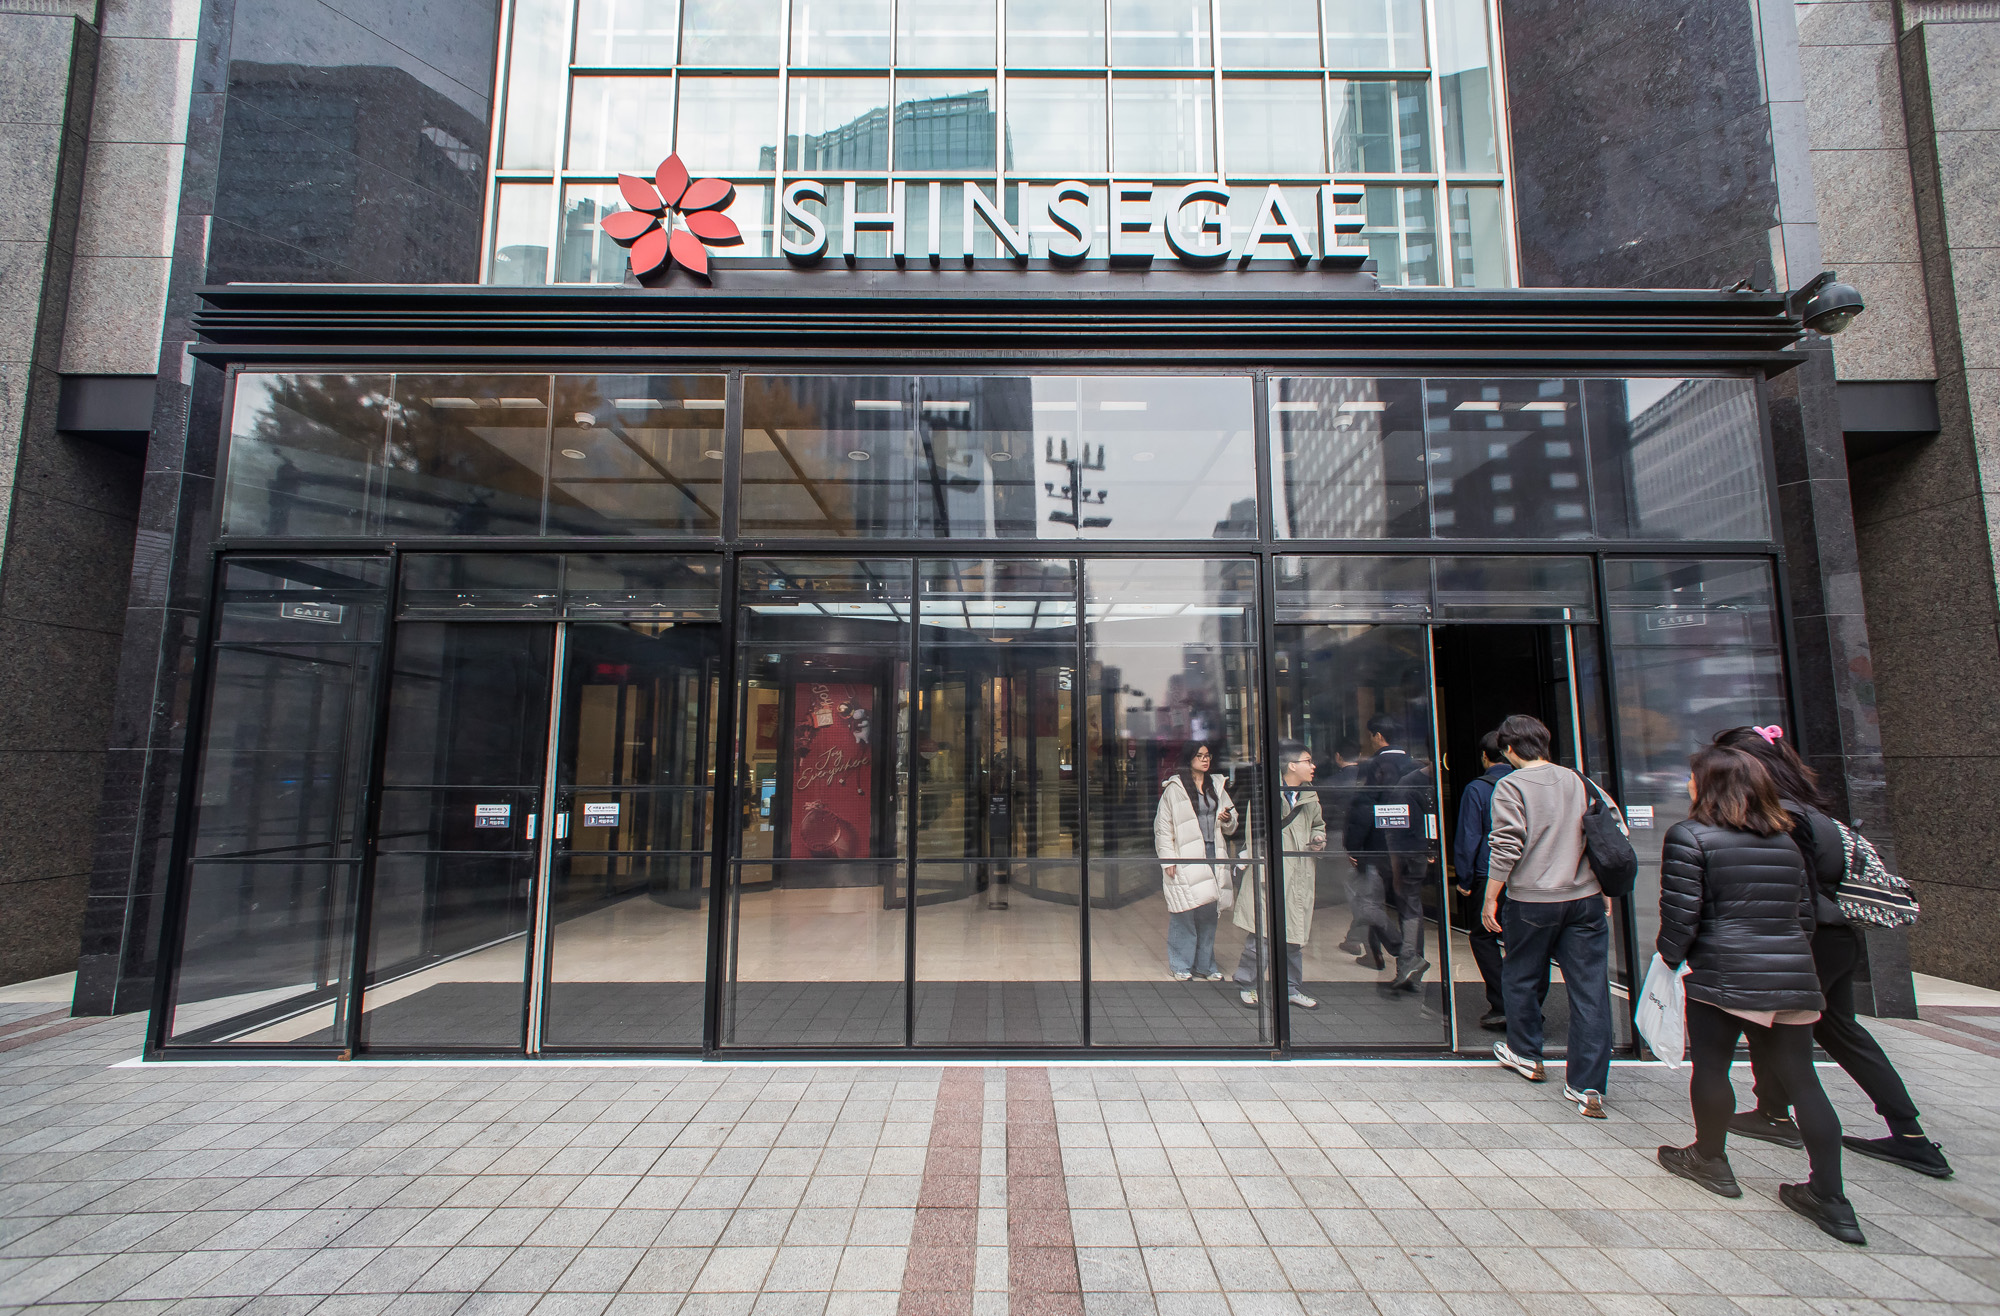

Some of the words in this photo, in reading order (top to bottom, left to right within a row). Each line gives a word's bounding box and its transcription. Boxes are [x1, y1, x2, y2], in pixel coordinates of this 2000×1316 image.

[782, 181, 1368, 265] SHINSEGAE
[294, 607, 330, 618] GATE
[1658, 614, 1694, 625] GATE
[816, 746, 843, 770] Joy
[797, 756, 869, 790] Everywhere
